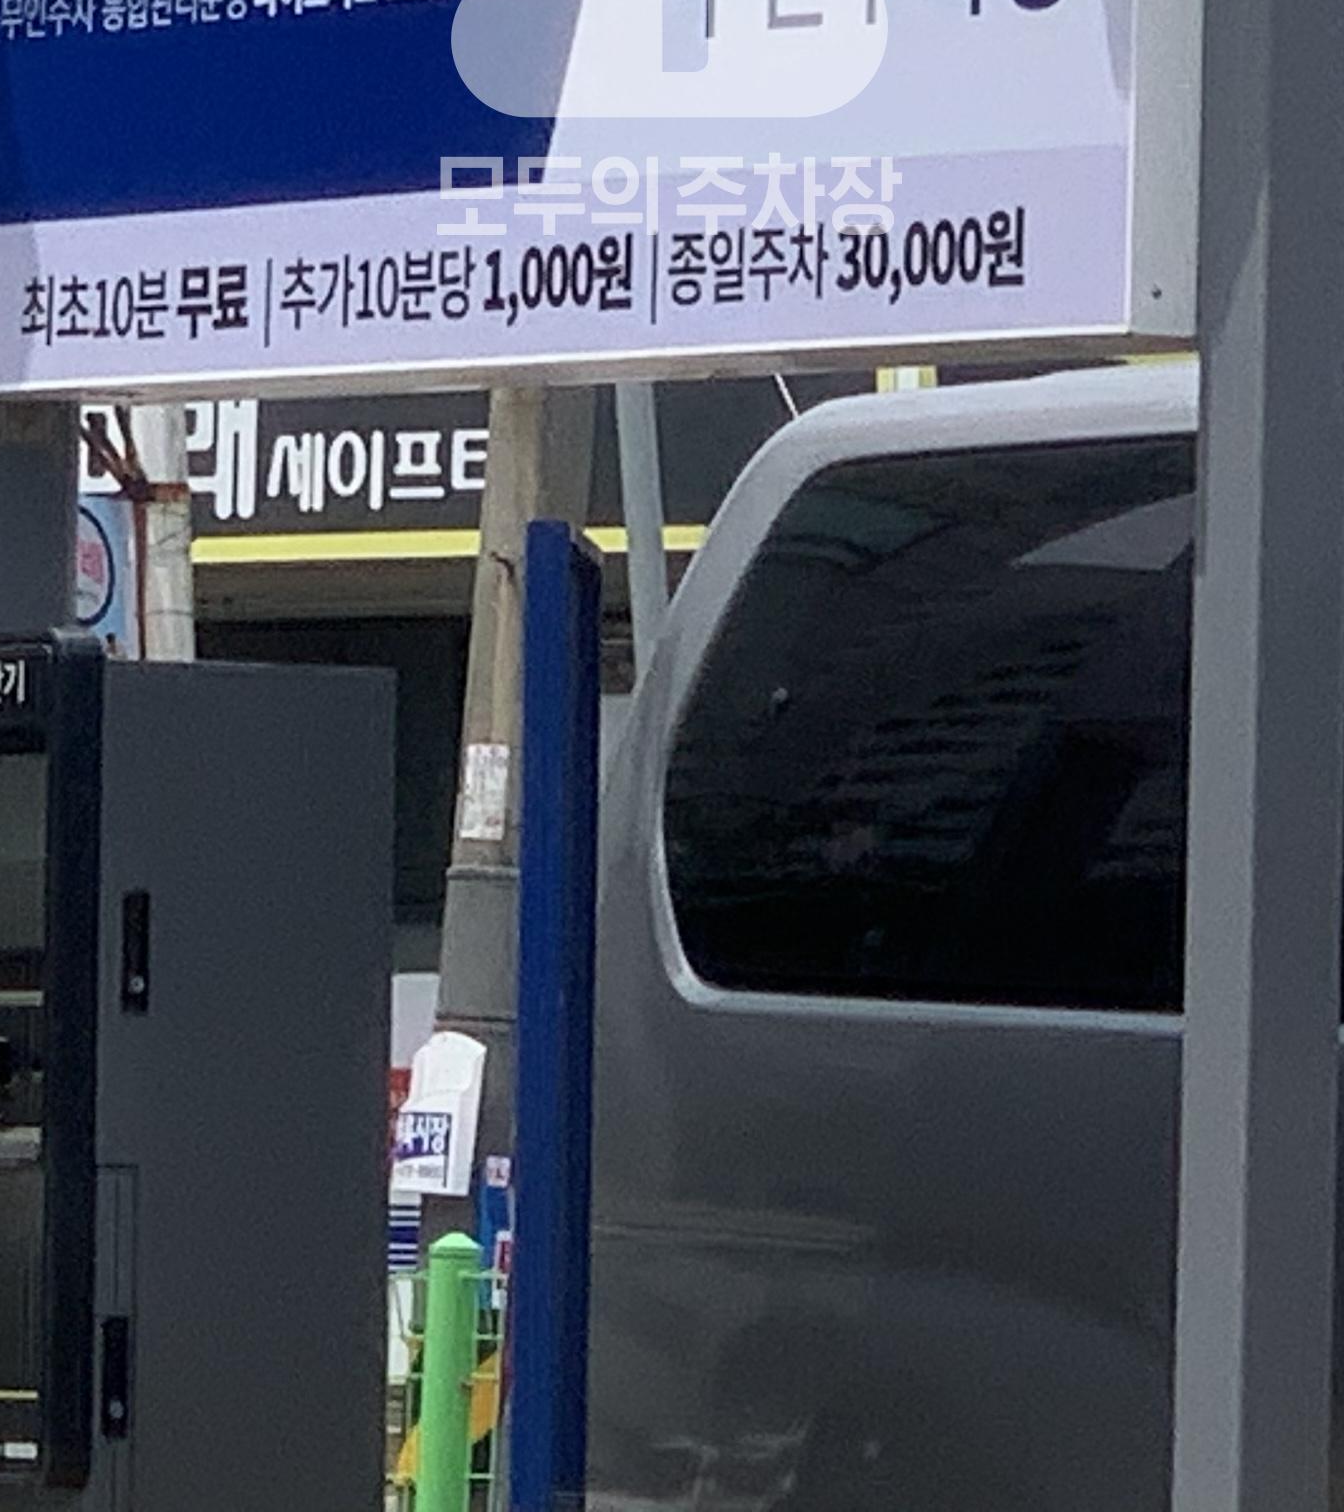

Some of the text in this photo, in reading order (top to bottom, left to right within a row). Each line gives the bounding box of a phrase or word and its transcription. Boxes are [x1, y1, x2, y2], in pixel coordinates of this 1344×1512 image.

[19, 204, 1026, 347] 최초10분 무료 추가10분당 1,000원 종일주차 30,000원
